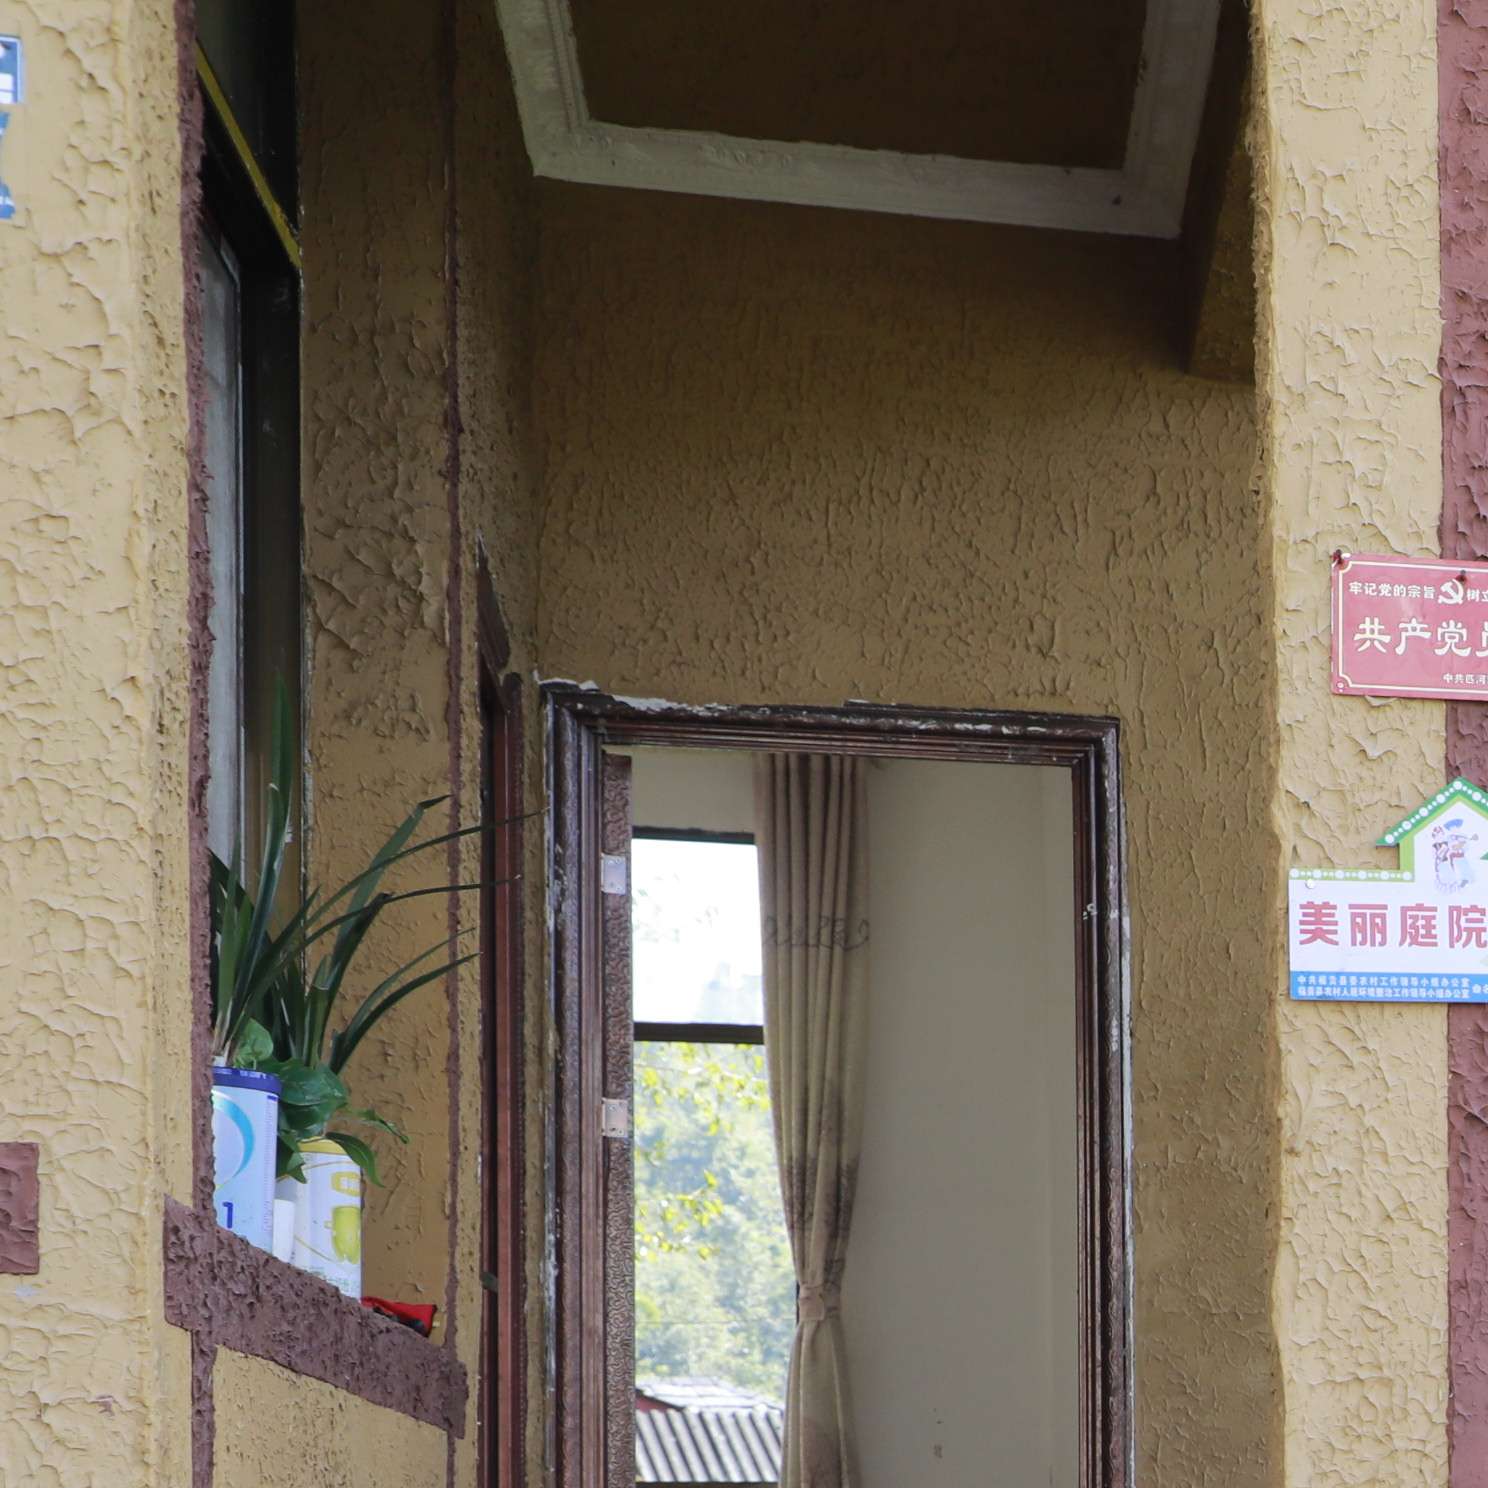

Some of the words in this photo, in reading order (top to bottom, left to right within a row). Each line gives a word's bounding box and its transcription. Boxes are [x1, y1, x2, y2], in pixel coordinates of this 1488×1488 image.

[1348, 581, 1436, 599] 牢记党的宗旨
[1298, 901, 1488, 949] 美丽庭院
